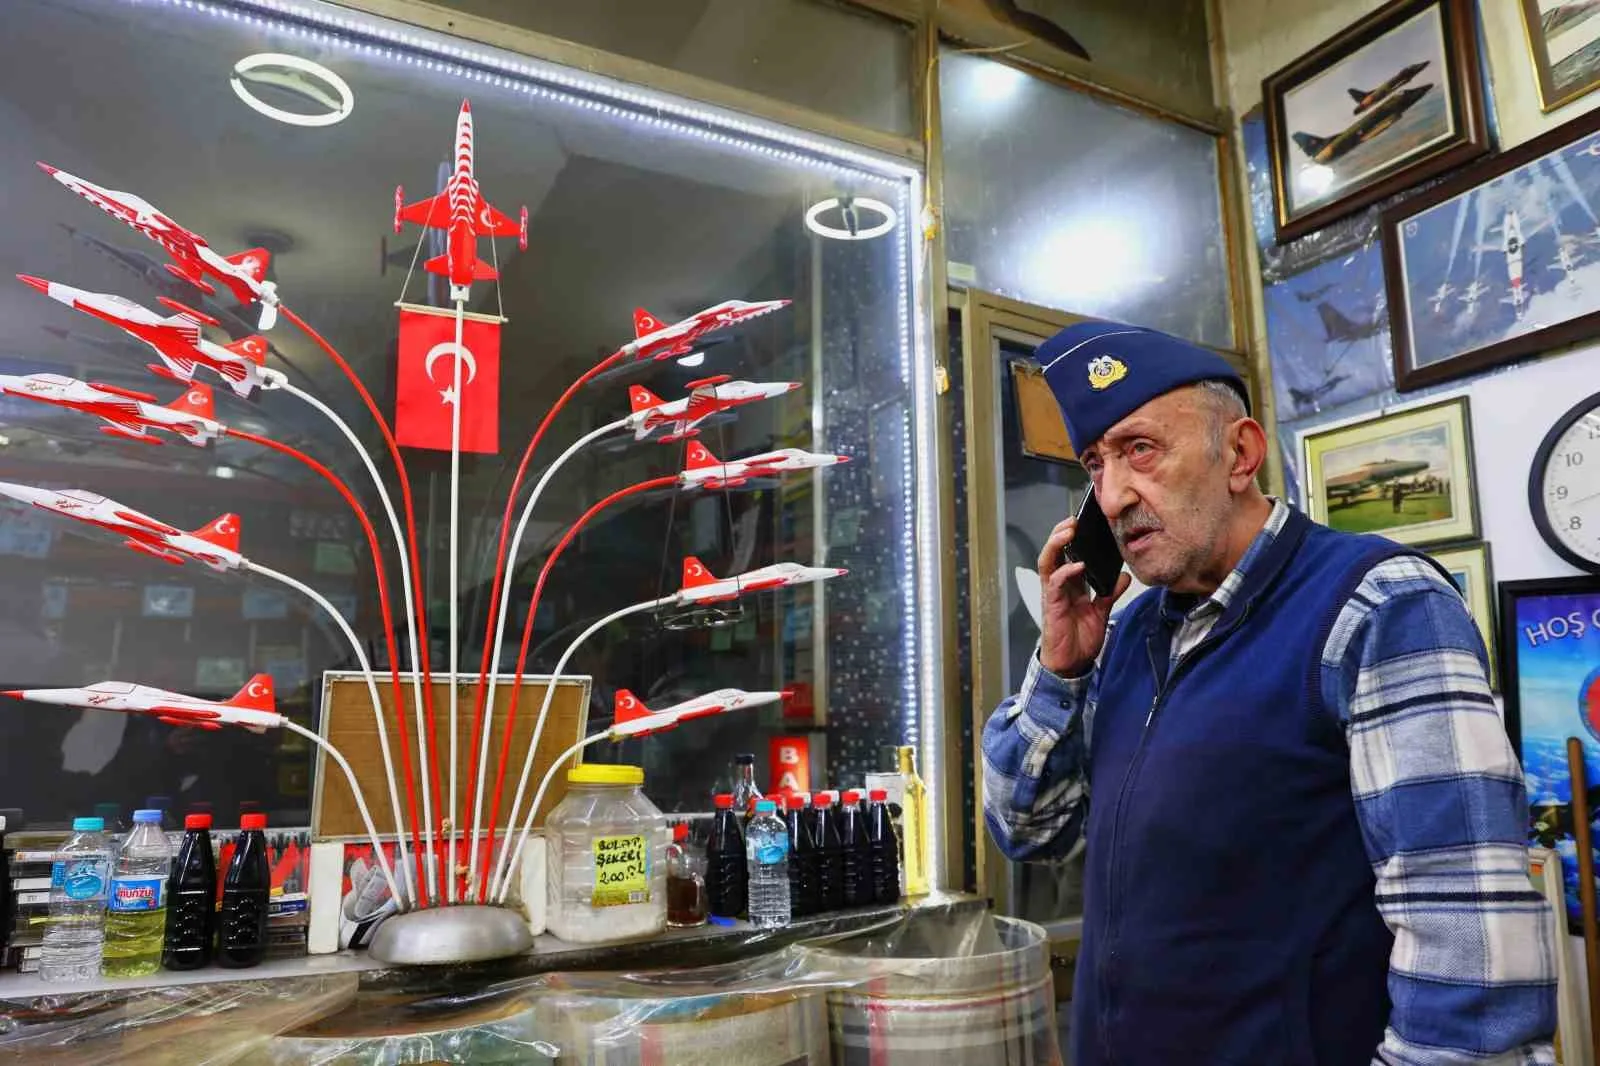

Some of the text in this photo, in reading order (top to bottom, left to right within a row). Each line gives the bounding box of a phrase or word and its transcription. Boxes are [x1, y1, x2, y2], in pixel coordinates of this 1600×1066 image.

[1566, 452, 1583, 467] 10
[1556, 486, 1568, 500] 9
[1570, 516, 1582, 530] 8
[1525, 611, 1585, 646] HOŞ
